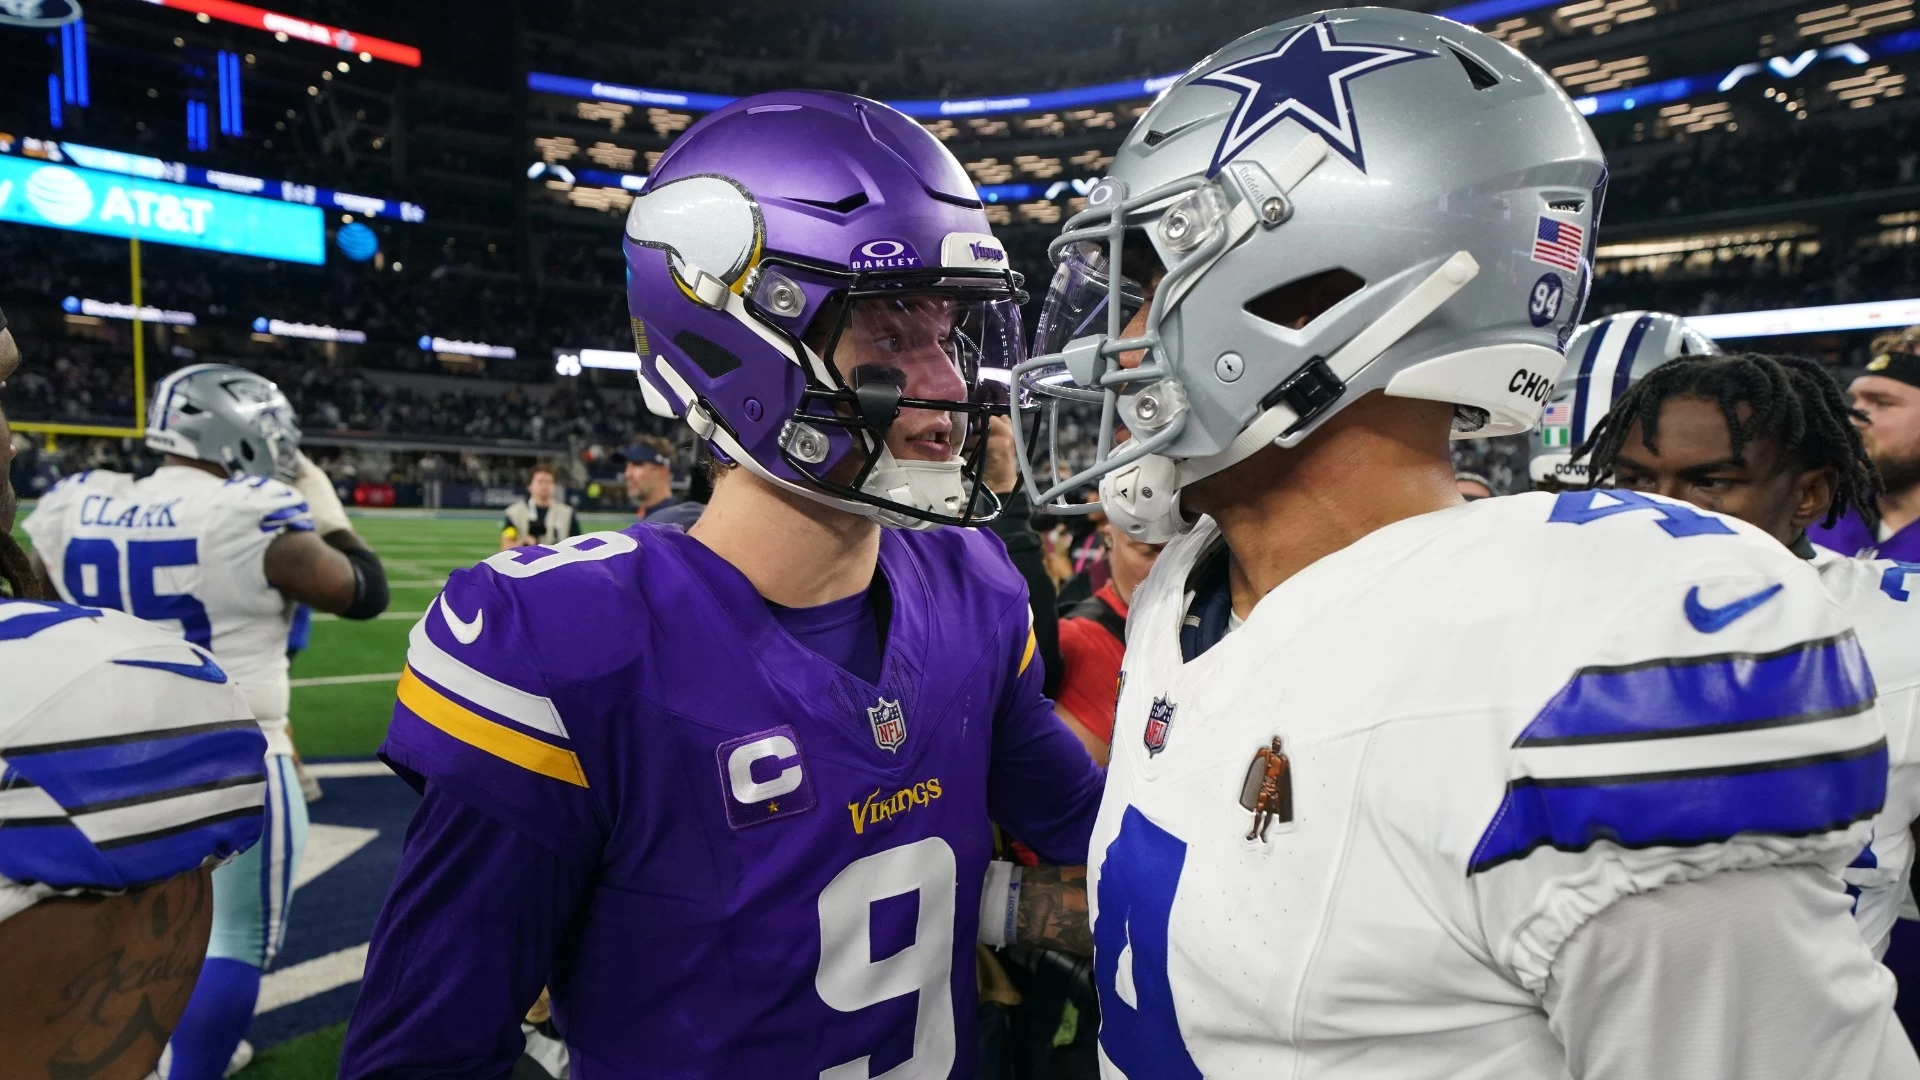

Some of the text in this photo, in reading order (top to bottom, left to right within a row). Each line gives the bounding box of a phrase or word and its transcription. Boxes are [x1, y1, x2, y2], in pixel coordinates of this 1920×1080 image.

[101, 186, 213, 234] AT&T
[852, 258, 916, 270] OAKLEY
[1531, 281, 1561, 319] 94
[80, 495, 183, 528] CLARK
[63, 537, 212, 656] 95
[878, 721, 903, 743] NFL
[1147, 719, 1166, 746] NFL
[728, 735, 803, 804] C
[815, 837, 956, 1080] 9
